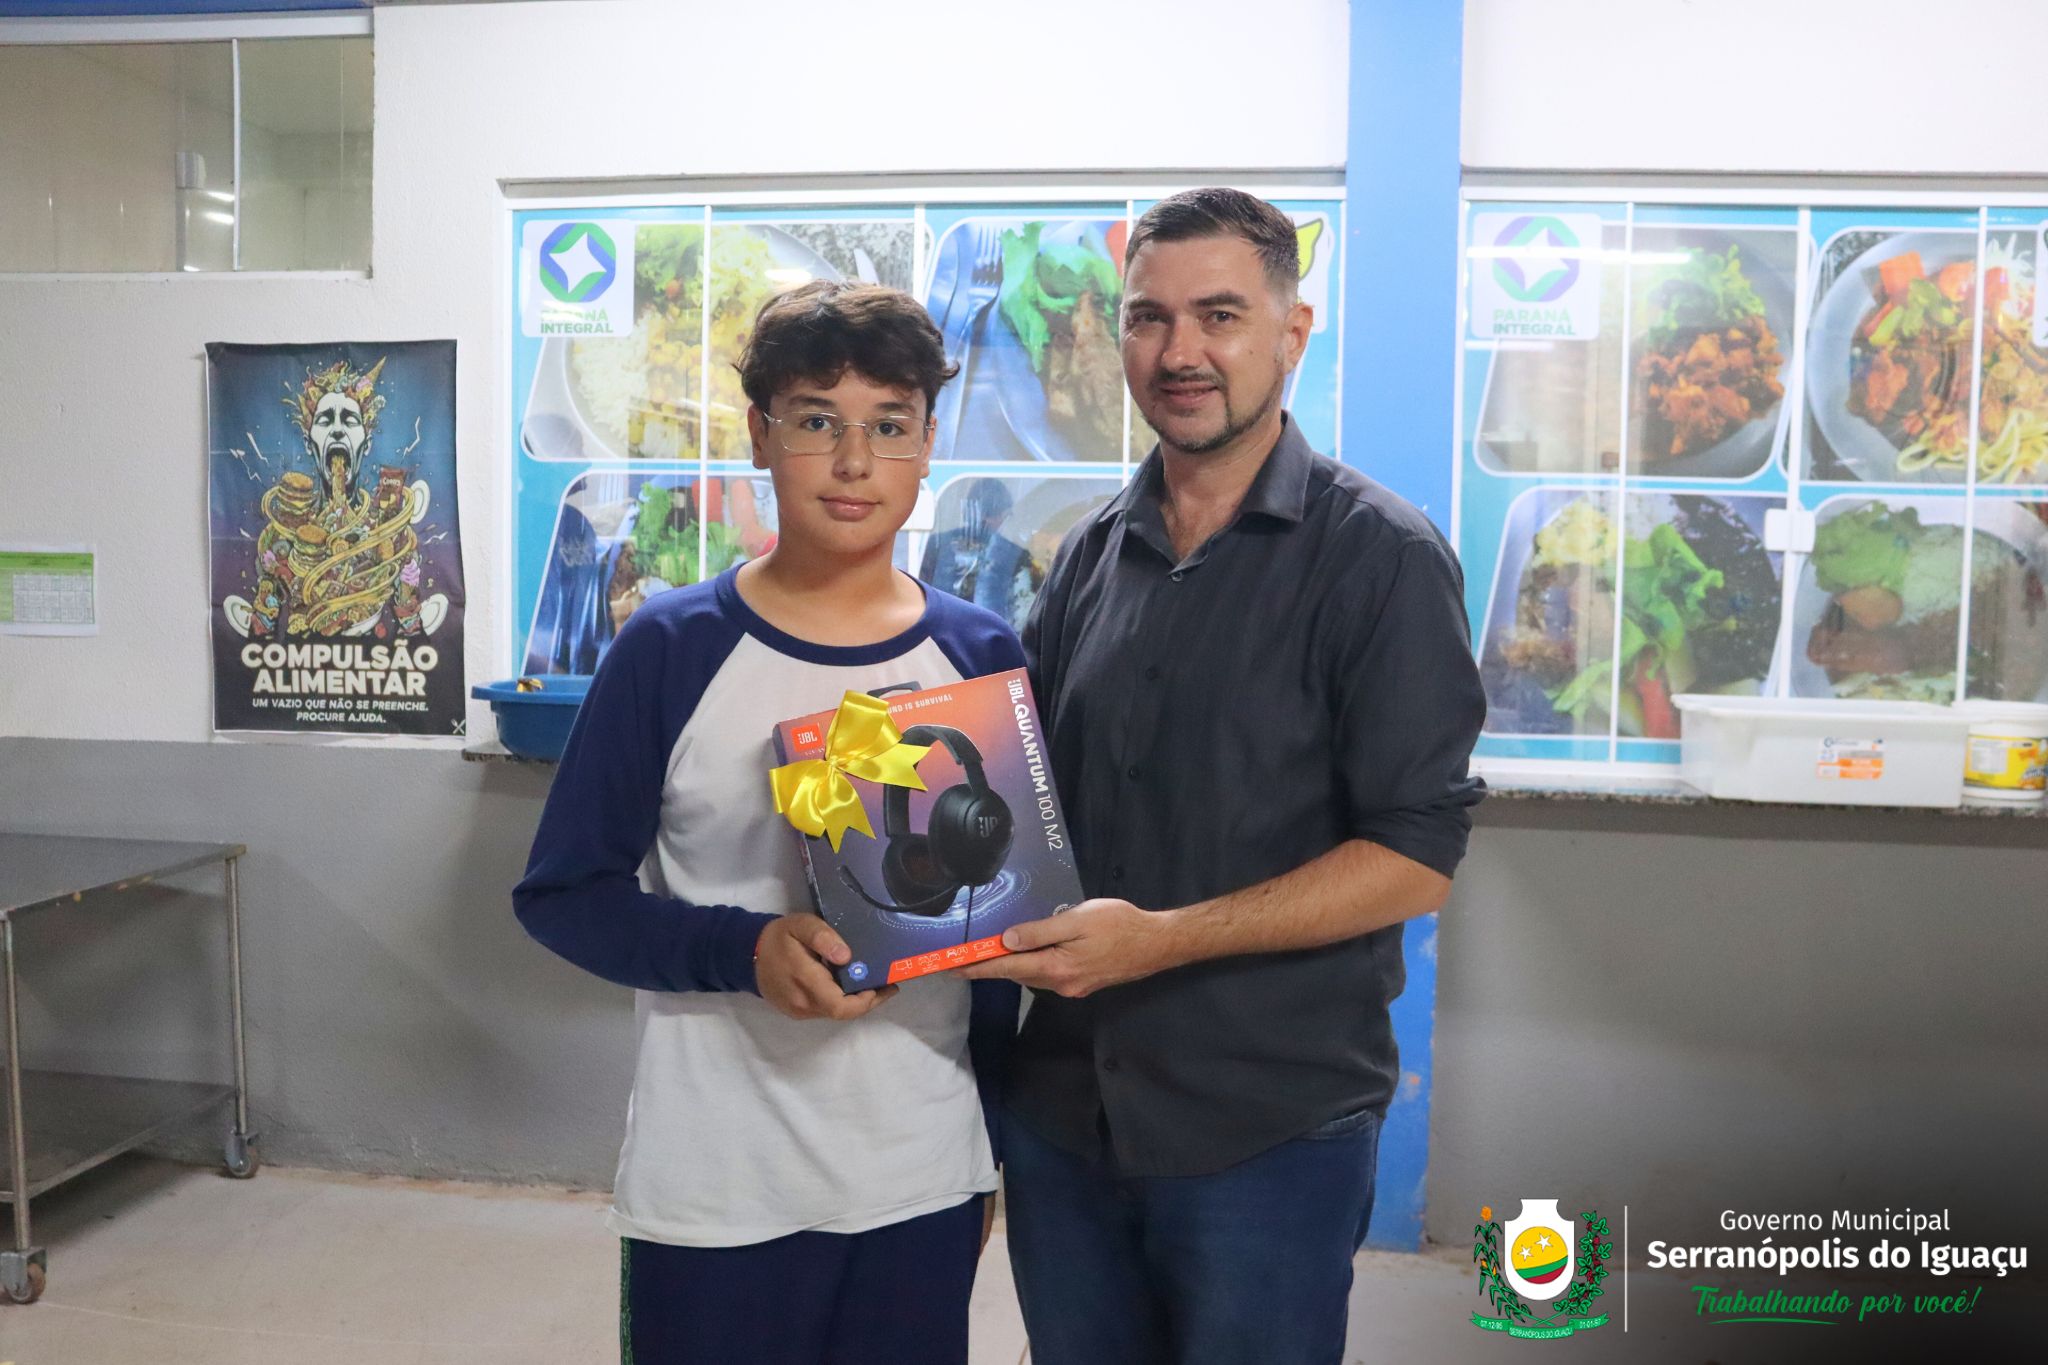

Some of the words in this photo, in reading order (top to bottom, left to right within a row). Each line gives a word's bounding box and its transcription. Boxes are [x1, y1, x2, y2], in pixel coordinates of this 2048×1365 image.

[541, 322, 614, 334] INTEGRAL
[1493, 322, 1577, 336] INTEGRAL
[241, 639, 438, 671] COMPULSÃO
[253, 669, 427, 696] ALIMENTAR
[1007, 678, 1025, 704] JBL
[252, 698, 269, 708] UM
[271, 698, 302, 709] VAZIO
[305, 699, 327, 710] QUE
[329, 697, 353, 709] NÃO
[356, 700, 370, 710] SE
[372, 700, 429, 712] PREENCHE.
[914, 693, 953, 708] SURVIVAL
[296, 711, 345, 722] PROCURE
[348, 712, 387, 724] AJUDA.
[797, 731, 818, 744] JBL
[1014, 704, 1049, 793] QUANTUM
[1037, 793, 1056, 820] 100
[1044, 823, 1064, 851] M2
